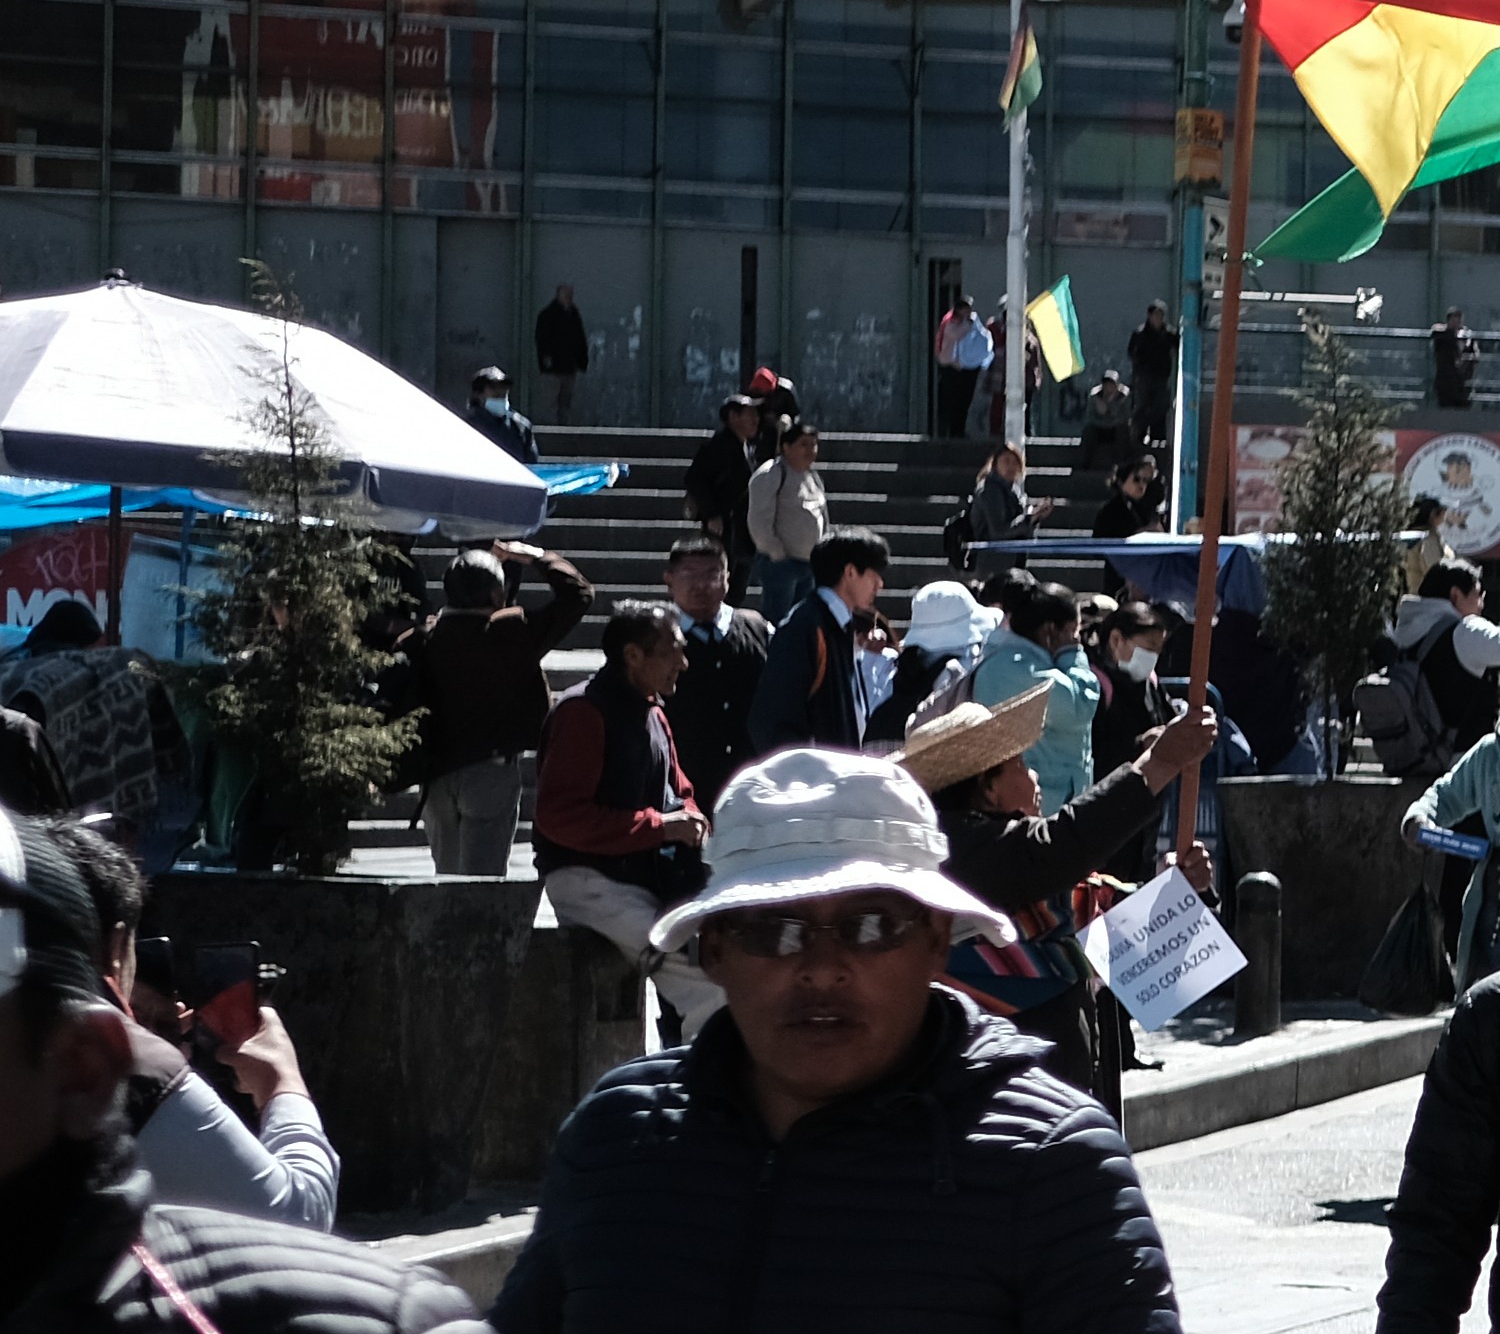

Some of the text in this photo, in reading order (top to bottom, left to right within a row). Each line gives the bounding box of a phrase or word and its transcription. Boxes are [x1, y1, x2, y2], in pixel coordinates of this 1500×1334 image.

[1115, 914, 1212, 987] VENCEREMOS UN
[1133, 908, 1179, 944] UNIDA
[1177, 892, 1198, 914] LO
[1135, 939, 1222, 1007] SOLO CORAZON
